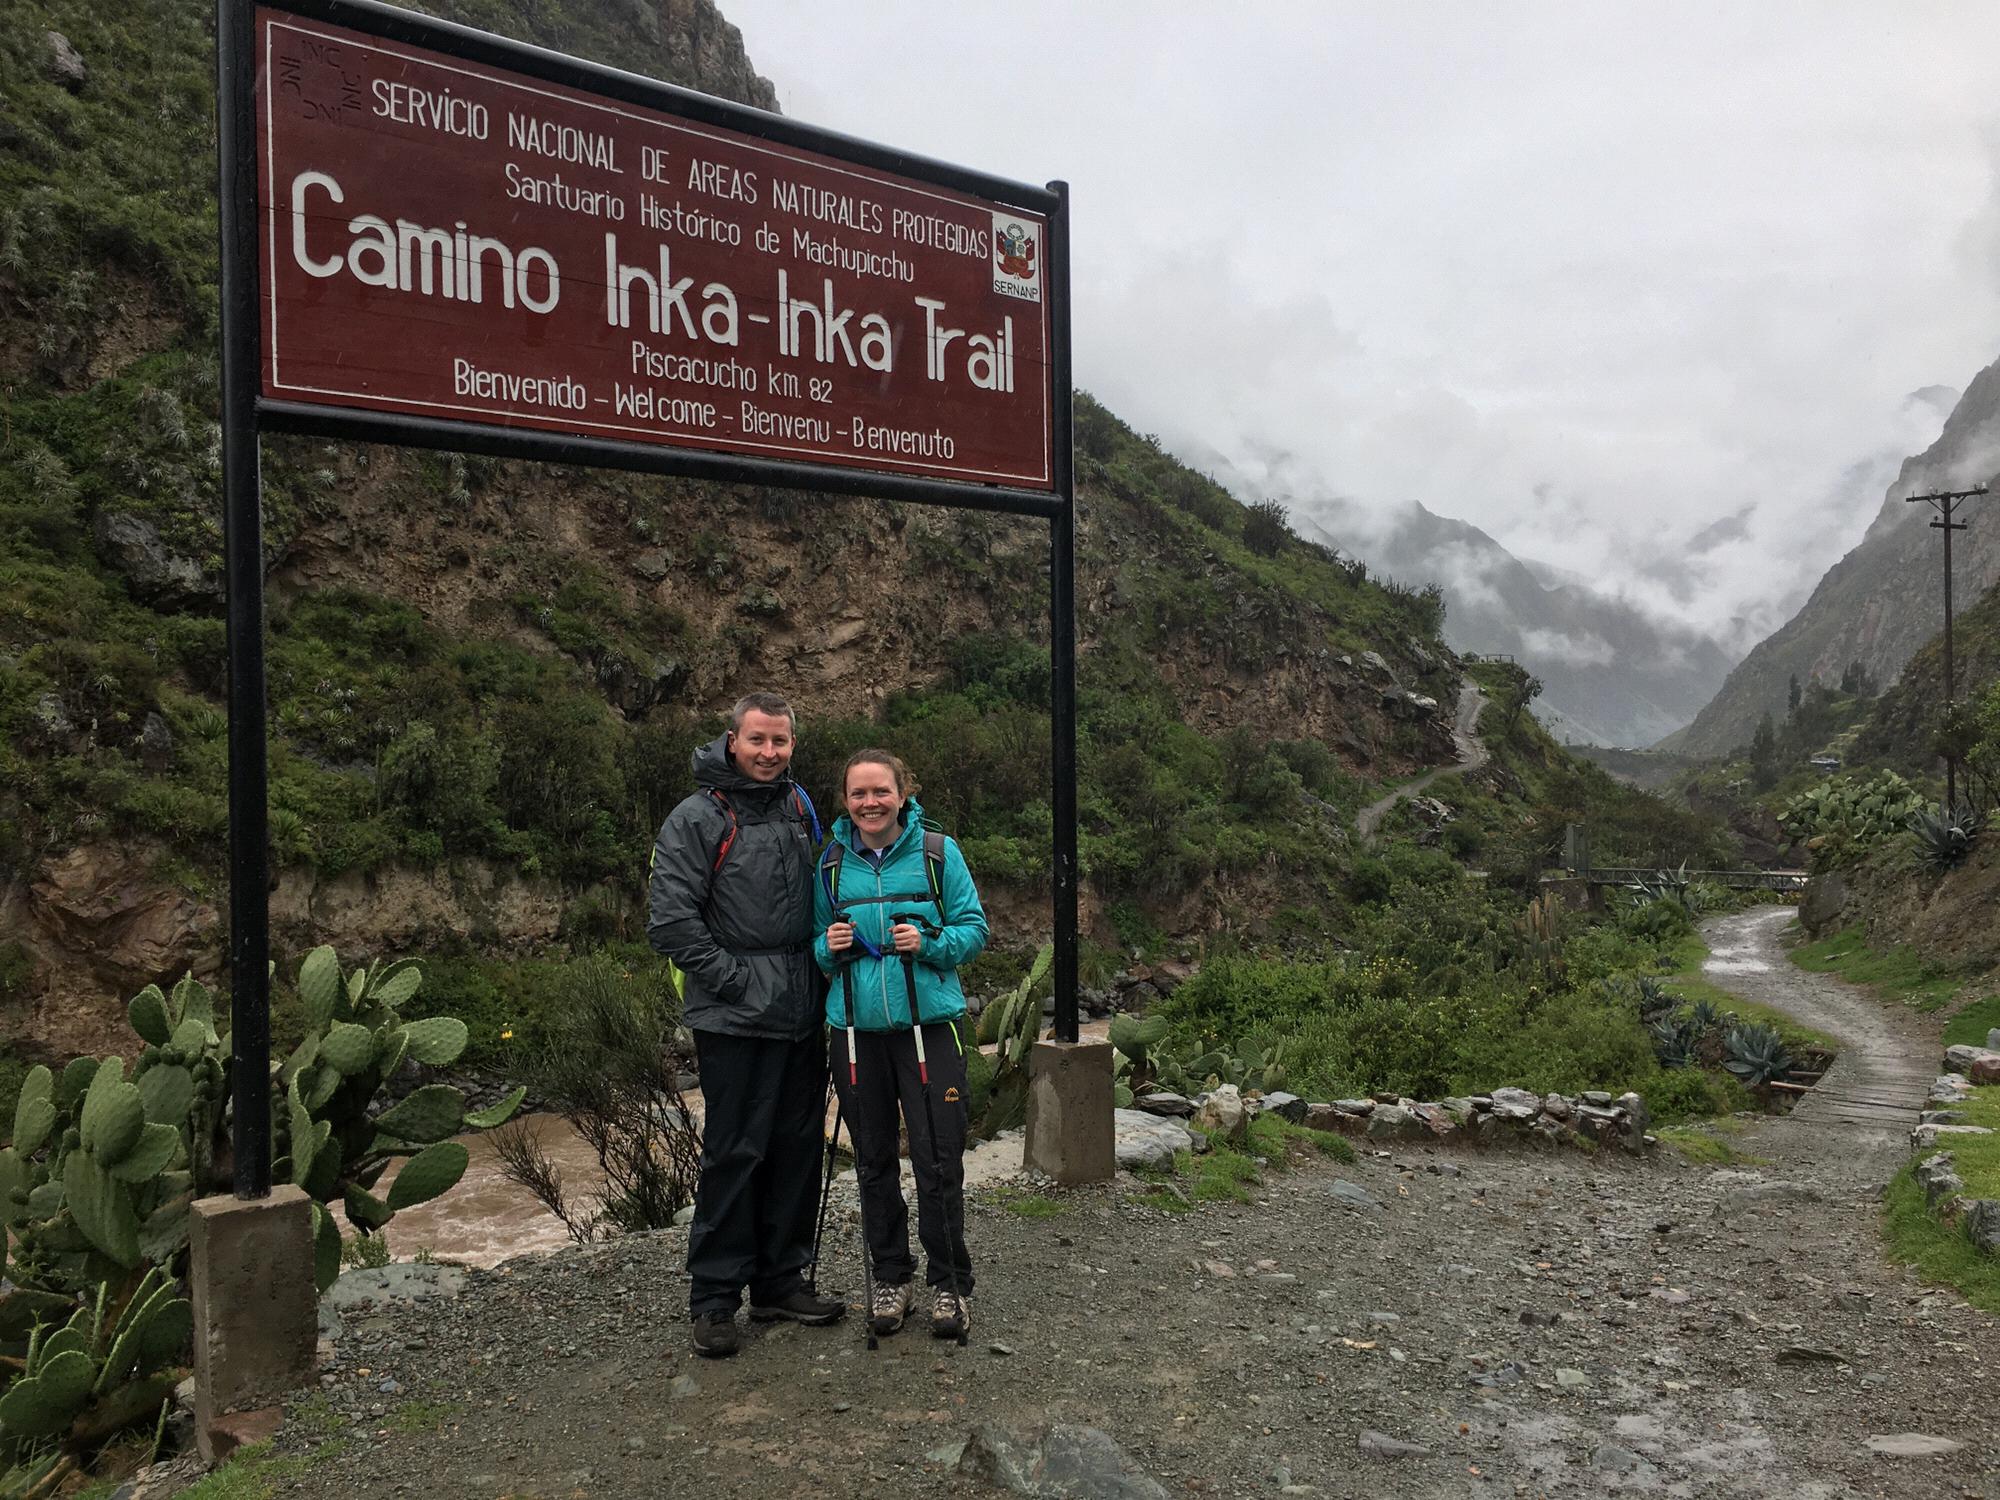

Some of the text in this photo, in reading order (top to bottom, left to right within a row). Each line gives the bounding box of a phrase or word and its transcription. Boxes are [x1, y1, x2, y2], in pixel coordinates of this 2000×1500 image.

[505, 162, 914, 283] Santuario Histórico de Machupicchu
[508, 112, 624, 174] NACIONAL
[641, 145, 670, 185] DE
[688, 158, 758, 205] AREAS
[773, 178, 883, 234] NATURALES
[893, 208, 988, 260] PROTEGIDAS
[291, 171, 560, 314] Camino
[914, 296, 1014, 393] Trail
[994, 280, 1039, 299] SERNANP
[454, 358, 587, 410] Bienvenido
[614, 382, 716, 428] Welcome
[741, 400, 830, 443] Bienvenu
[852, 416, 955, 459] Benvenuto
[632, 340, 757, 392] Piscacucho
[809, 377, 833, 404] 82
